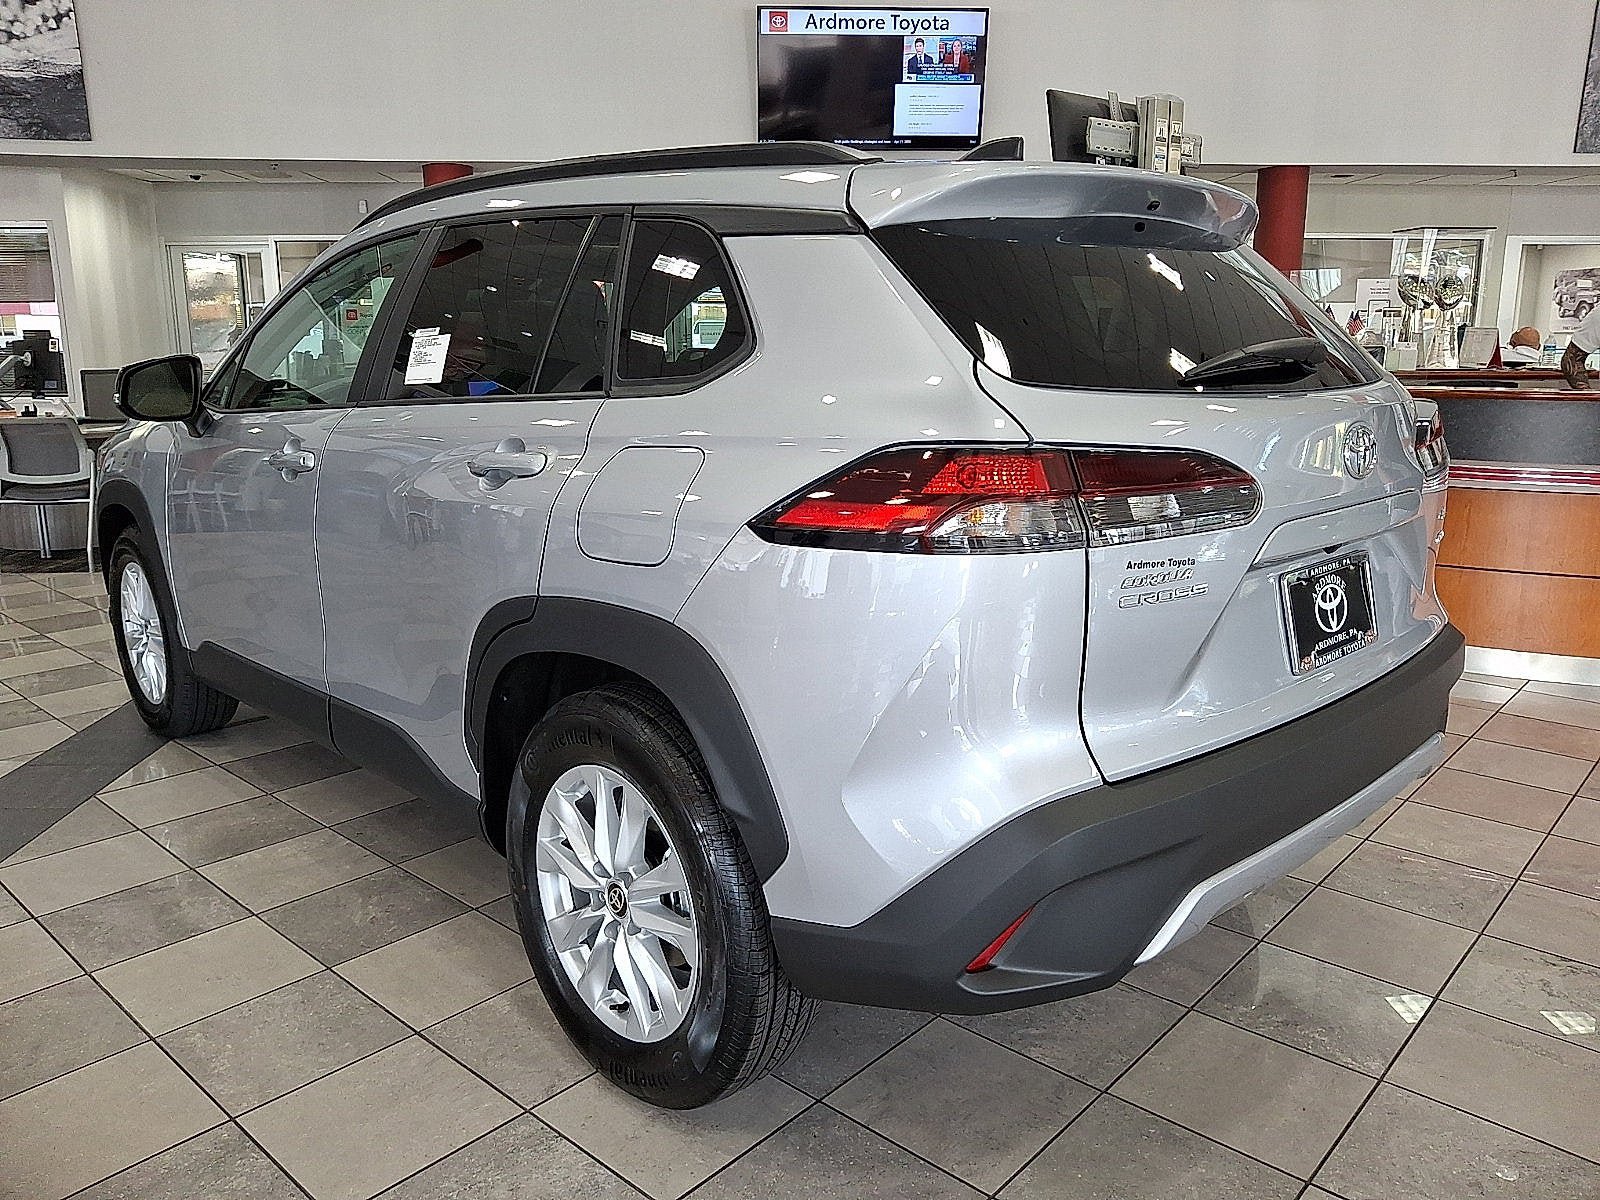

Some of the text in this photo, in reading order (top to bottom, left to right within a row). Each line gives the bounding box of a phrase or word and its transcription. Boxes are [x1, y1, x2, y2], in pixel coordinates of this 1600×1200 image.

[805, 13, 950, 34] Ardmore Toyota
[1126, 557, 1196, 570] Ardmore Toyota
[1343, 558, 1351, 566] PA
[1120, 567, 1195, 590] COROLLA
[1118, 582, 1209, 609] CROSS
[1349, 627, 1358, 637] PA
[1315, 639, 1366, 668] ARDMORE TOYOTA
